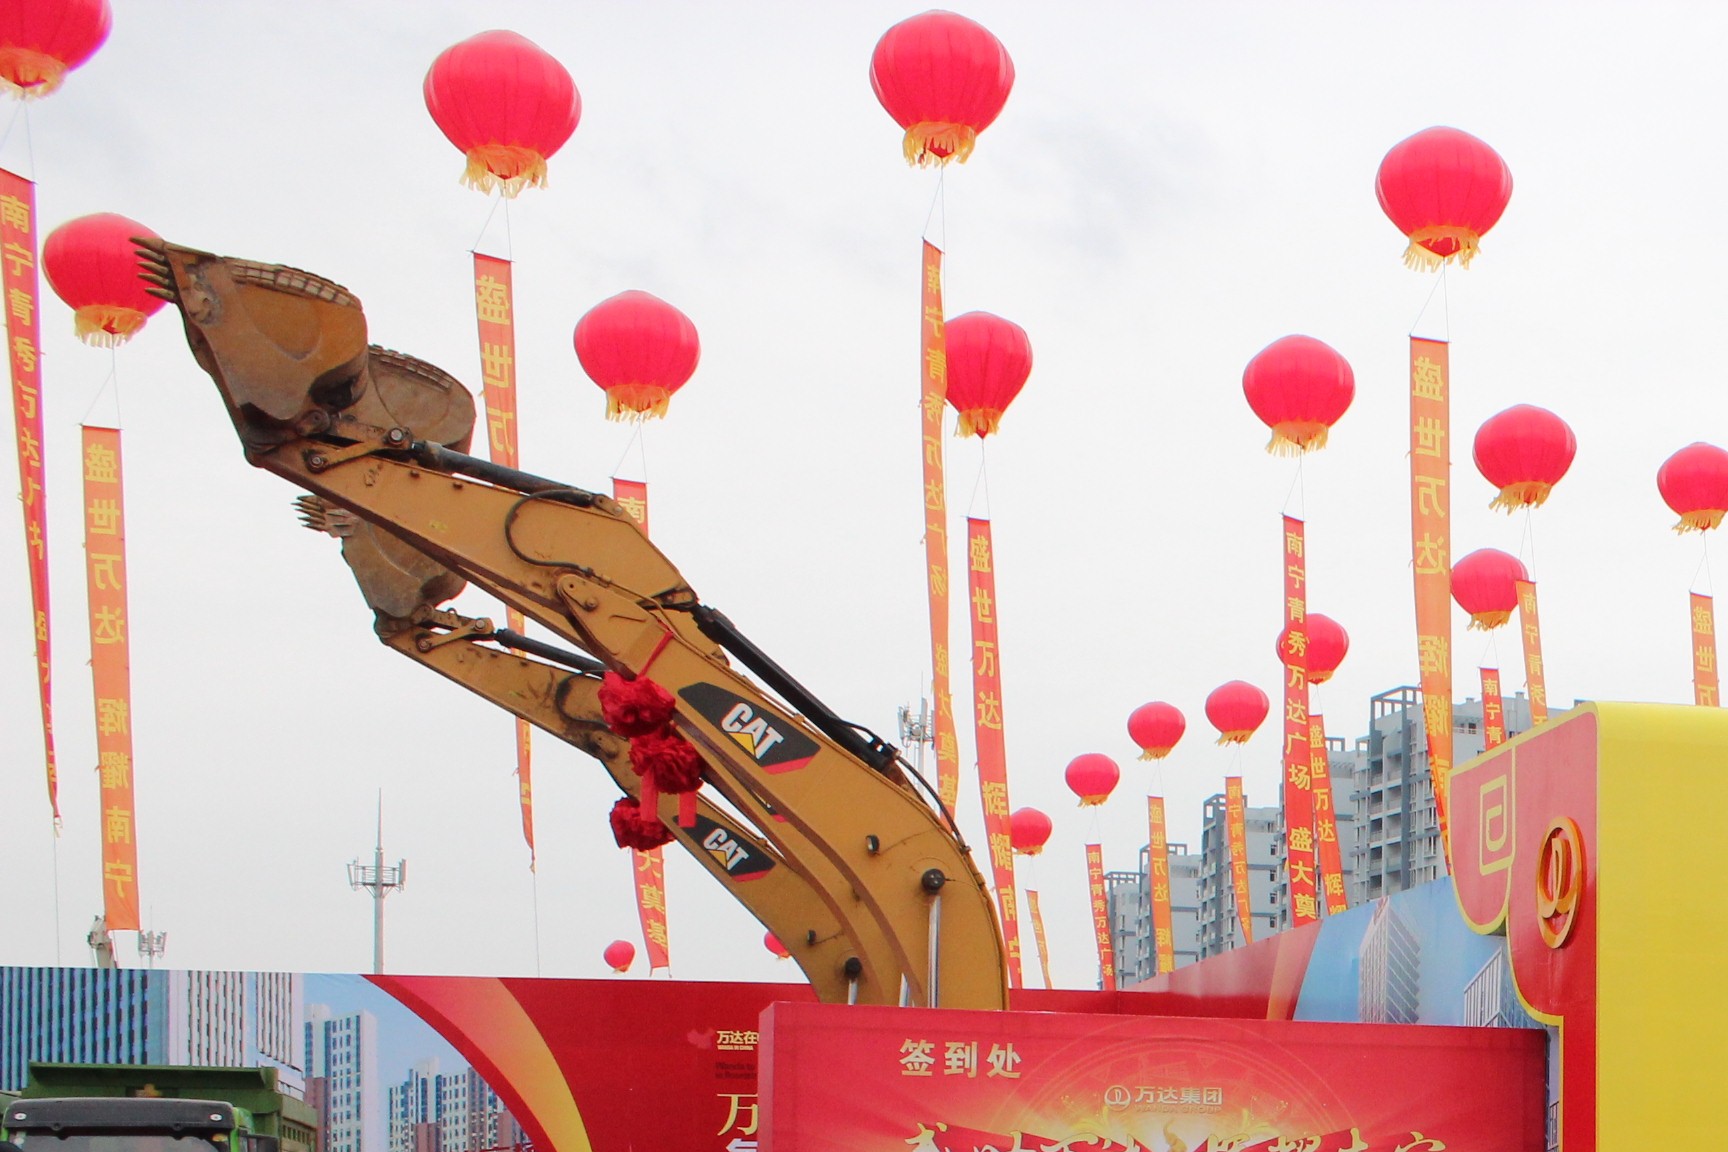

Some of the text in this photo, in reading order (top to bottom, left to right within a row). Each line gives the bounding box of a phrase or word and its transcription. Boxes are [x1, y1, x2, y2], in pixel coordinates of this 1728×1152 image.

[970, 534, 1002, 731] 盛世万达
[720, 701, 785, 761] CAT
[1285, 531, 1316, 920] 南宁青秀万达广场 盛大奠
[1483, 678, 1503, 744] 南宁青
[1310, 724, 1336, 842] 盛世万达
[702, 826, 750, 873] CAT
[1088, 851, 1113, 977] 南宁青秀万达广场
[716, 1030, 759, 1045] 万达在
[899, 1038, 1022, 1079] 签到处
[1135, 1086, 1223, 1106] 万达集团
